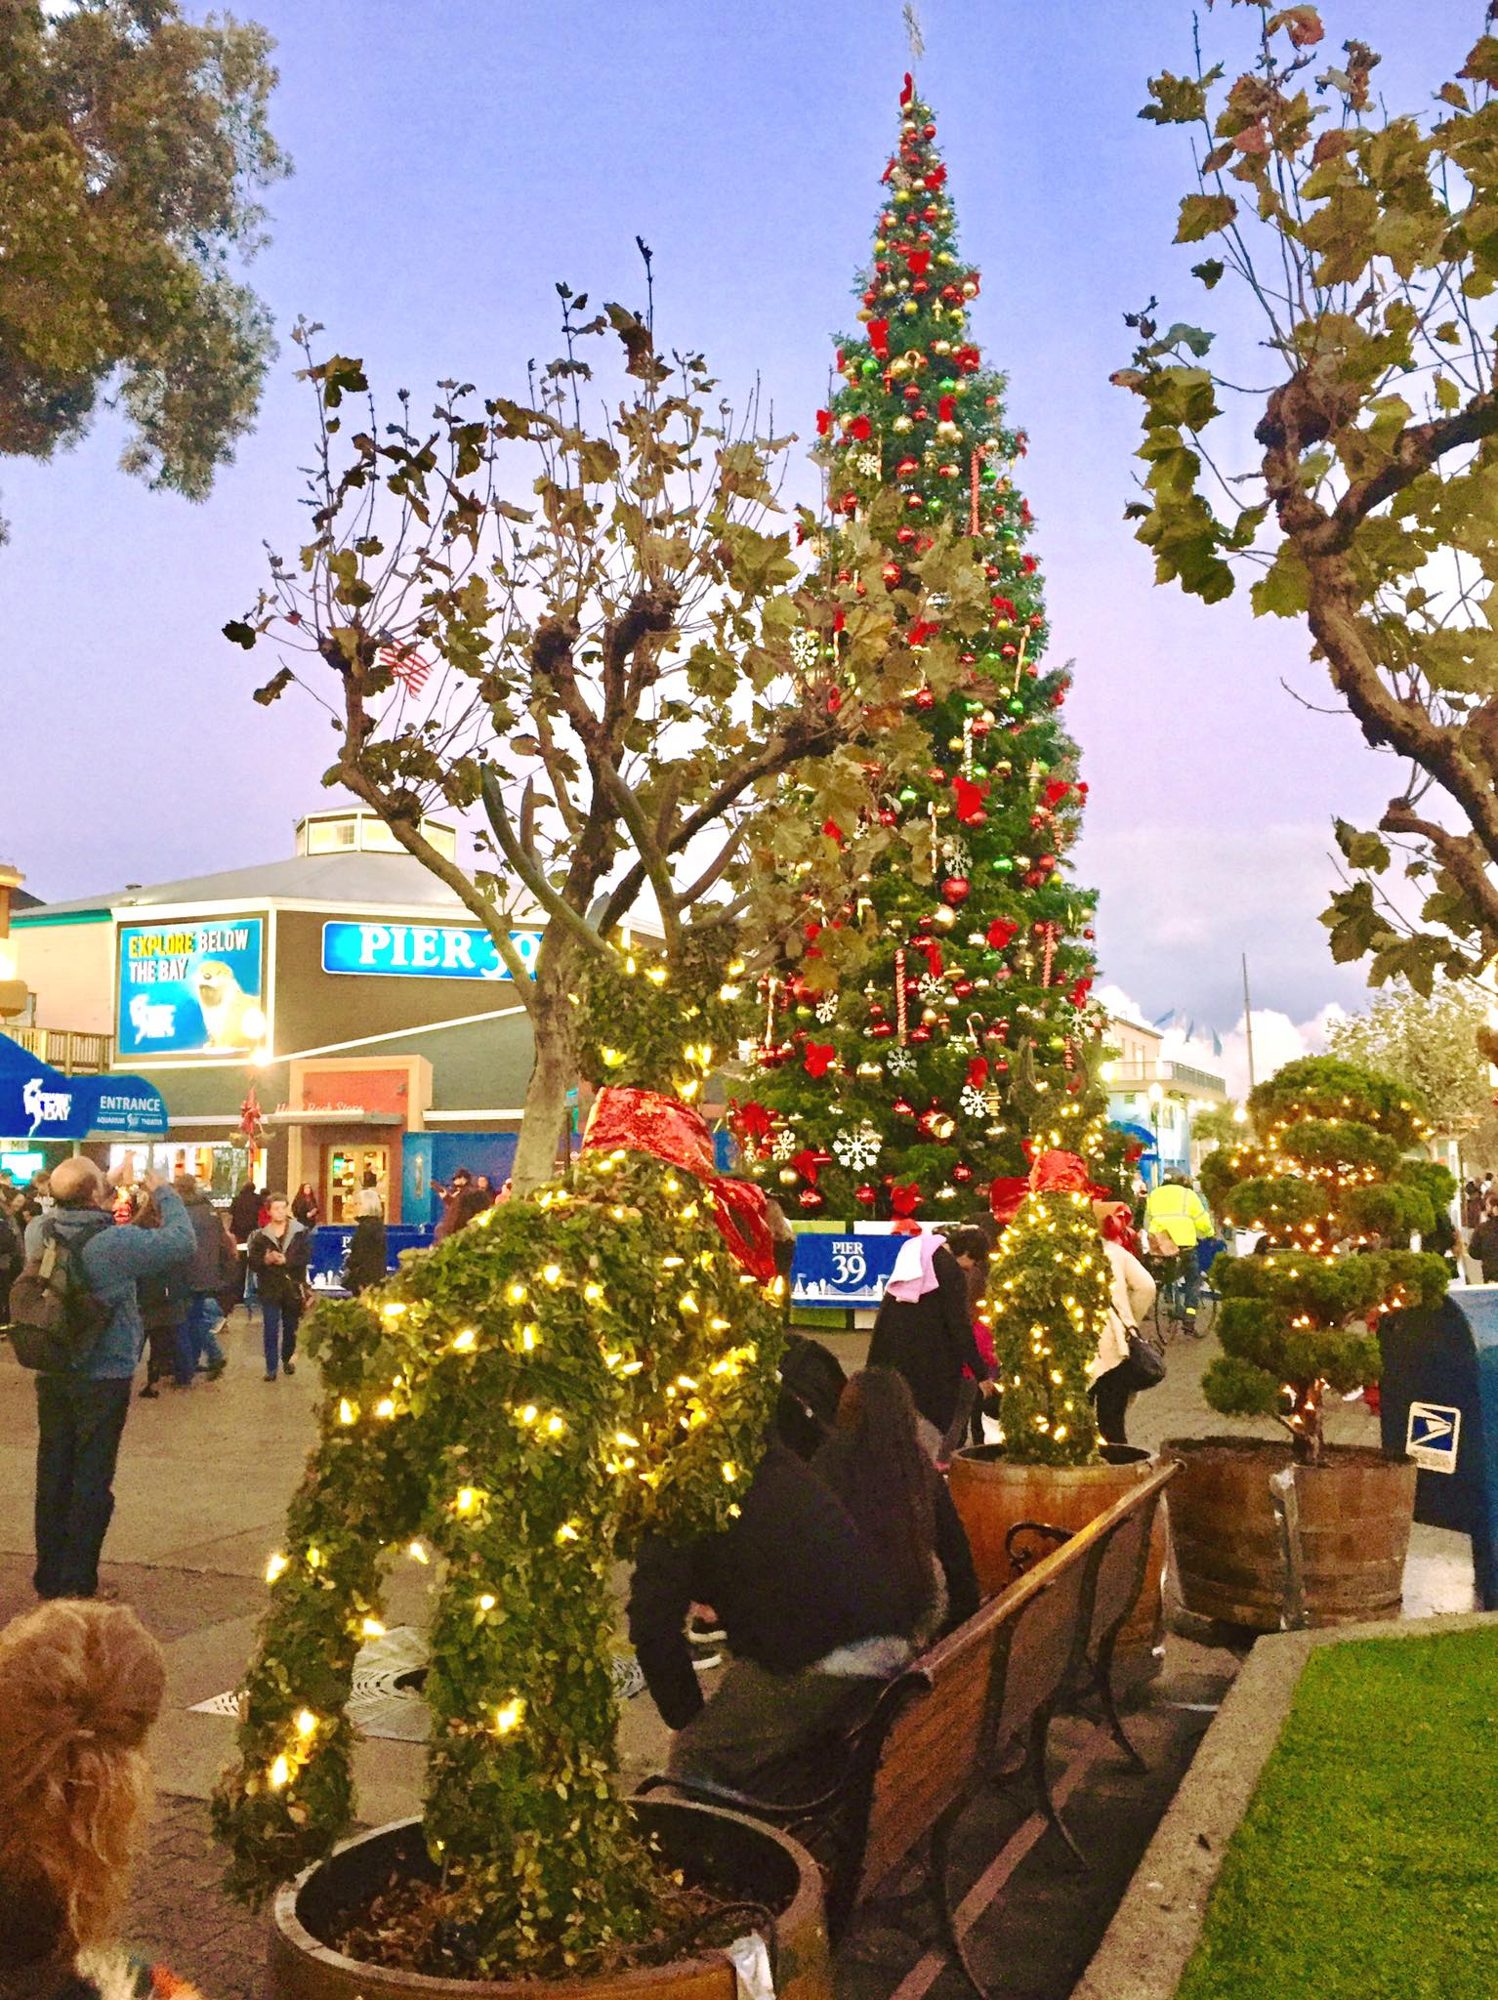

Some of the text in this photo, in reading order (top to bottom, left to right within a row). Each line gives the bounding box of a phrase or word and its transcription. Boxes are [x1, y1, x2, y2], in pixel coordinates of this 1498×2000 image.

[130, 929, 248, 957] EXPLORE BELOW
[359, 926, 475, 968] PIER
[129, 958, 188, 983] THE BAY
[100, 1096, 160, 1111] ENTRANCE
[832, 1242, 864, 1254] PIER
[831, 1255, 867, 1284] 39
